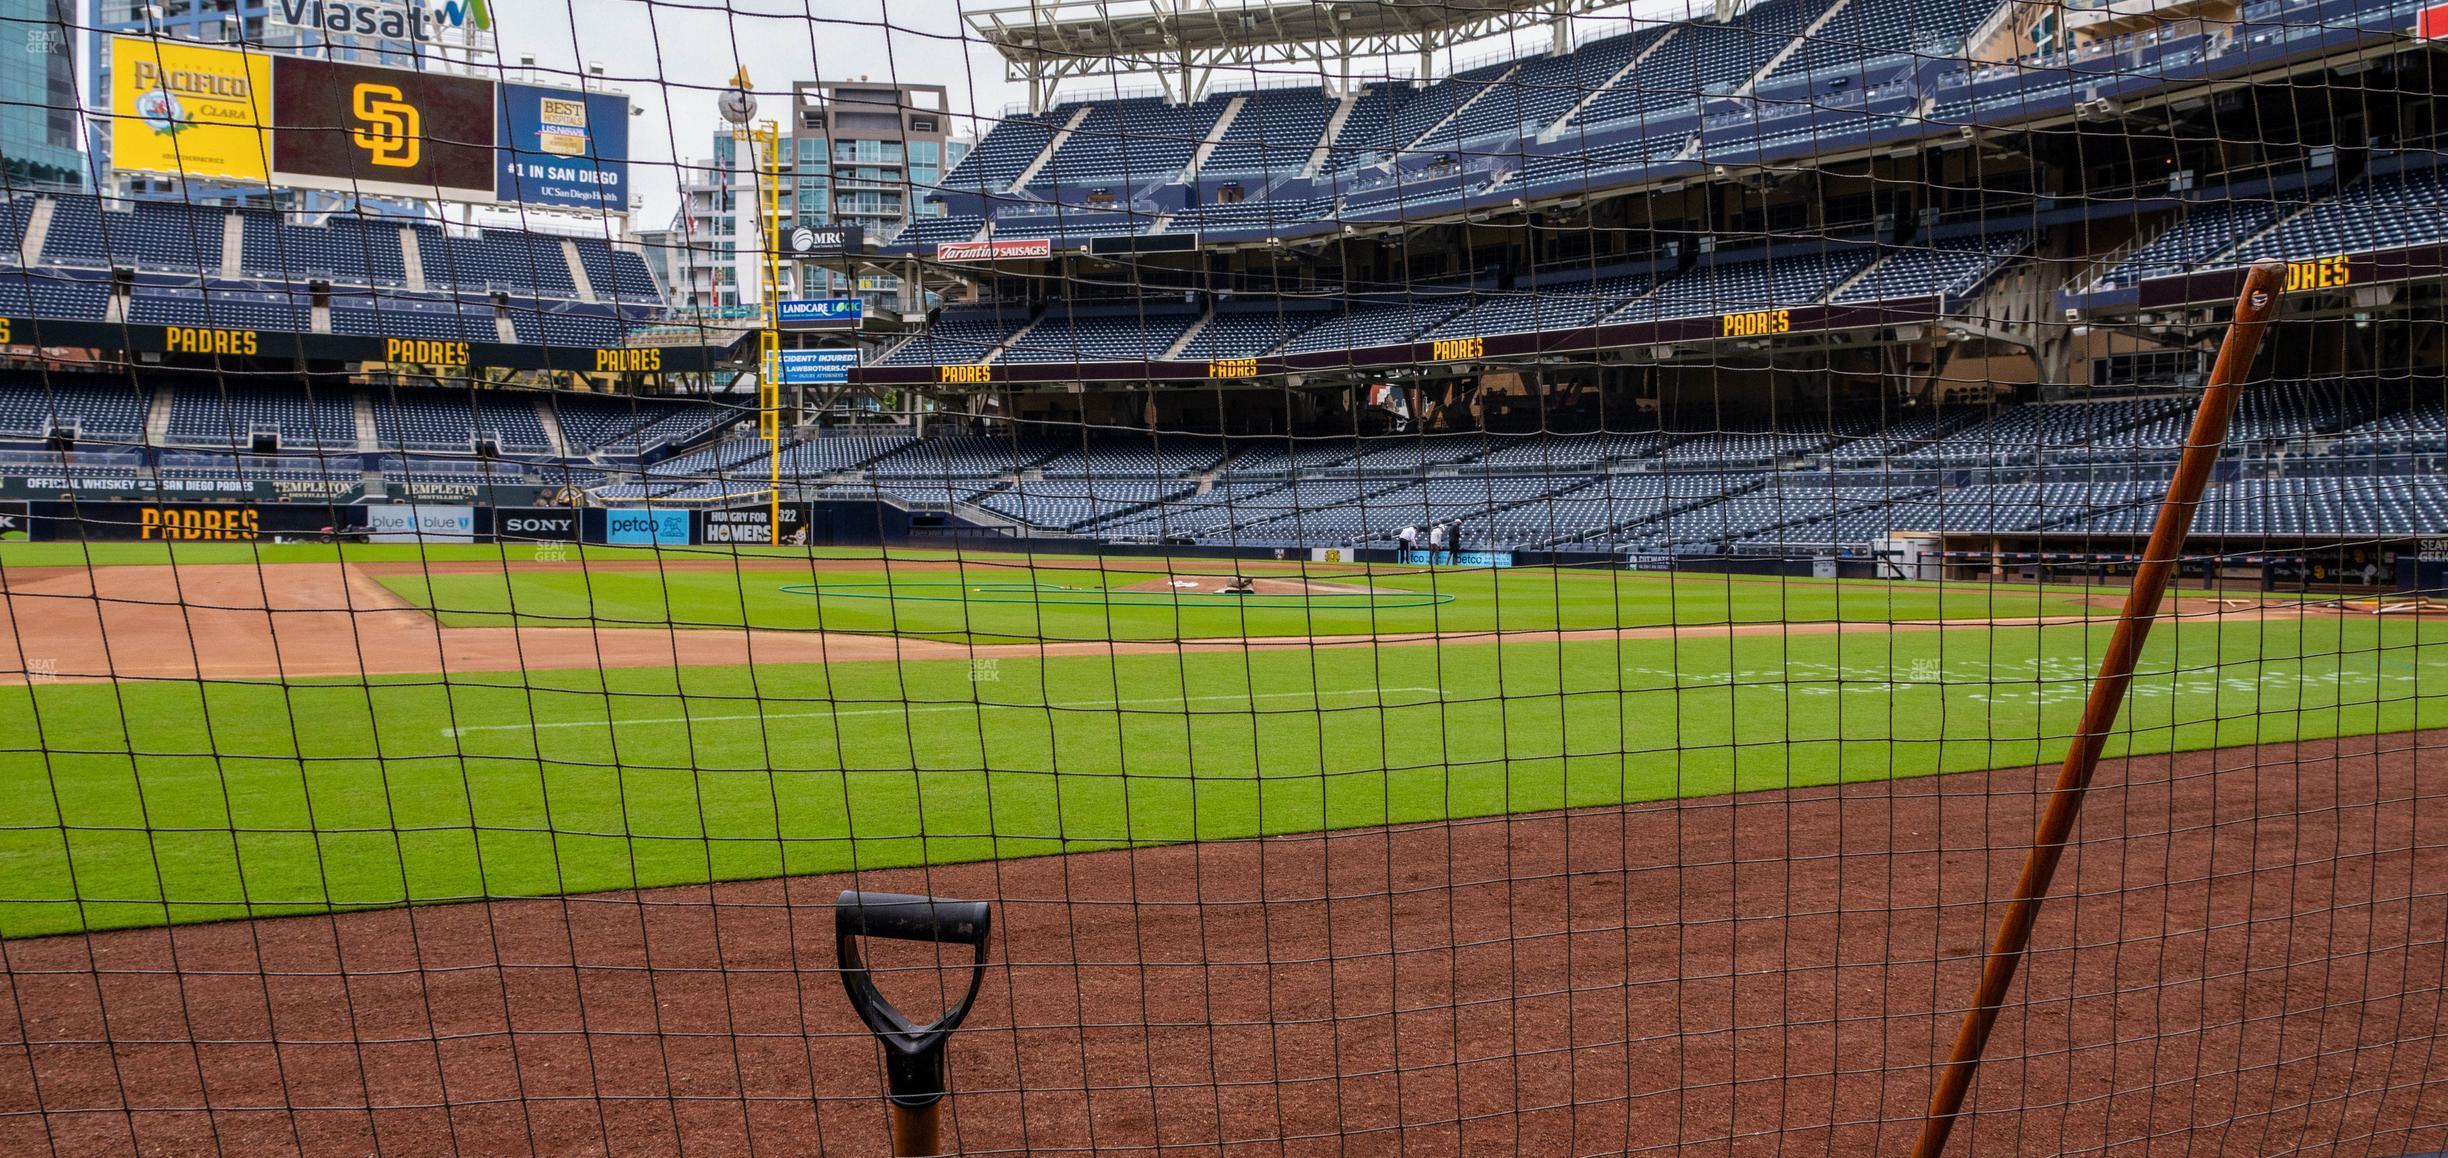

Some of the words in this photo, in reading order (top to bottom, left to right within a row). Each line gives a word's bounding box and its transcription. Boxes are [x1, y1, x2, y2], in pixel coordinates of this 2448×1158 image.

[281, 0, 430, 41] Viasat
[134, 60, 248, 97] PACIFICO
[200, 104, 246, 120] CLARA
[545, 101, 583, 116] BEST
[508, 163, 524, 177] #1
[529, 165, 543, 179] IN
[548, 167, 575, 182] SAN
[579, 170, 618, 186] DIEGO
[541, 186, 555, 196] UC
[555, 187, 570, 198] San
[570, 189, 592, 201] Diego
[592, 191, 618, 202] Health
[813, 232, 845, 244] MRC
[940, 245, 998, 259] Tarantino
[1001, 246, 1047, 257] SAUSAGES
[2284, 256, 2350, 291] DRES
[783, 303, 828, 314] LANDCARE
[831, 302, 860, 313] LOGIC
[1723, 310, 1789, 337] PADRES
[167, 326, 257, 355] PADRES
[1433, 337, 1483, 360] PADRES
[387, 338, 470, 366] PADRES
[596, 347, 661, 372] PADRES
[941, 365, 990, 383] PADRES
[1209, 358, 1257, 378] PADRES
[27, 478, 81, 490] OFFICIAL
[83, 479, 135, 490] WHISKEY
[163, 480, 183, 491] SAN
[186, 481, 214, 491] DIEGO
[217, 481, 254, 492] PADRES
[272, 481, 352, 493] TEMPLETON
[402, 483, 478, 496] TEMPLETON
[141, 507, 259, 540] PADRES
[372, 516, 404, 528] blue
[424, 516, 455, 529] blue
[712, 511, 748, 522] HUNGRY
[749, 512, 767, 523] FOR
[779, 509, 797, 522] 322
[507, 519, 572, 532] SONY
[612, 517, 660, 535] petco
[707, 524, 772, 542] HOMERS
